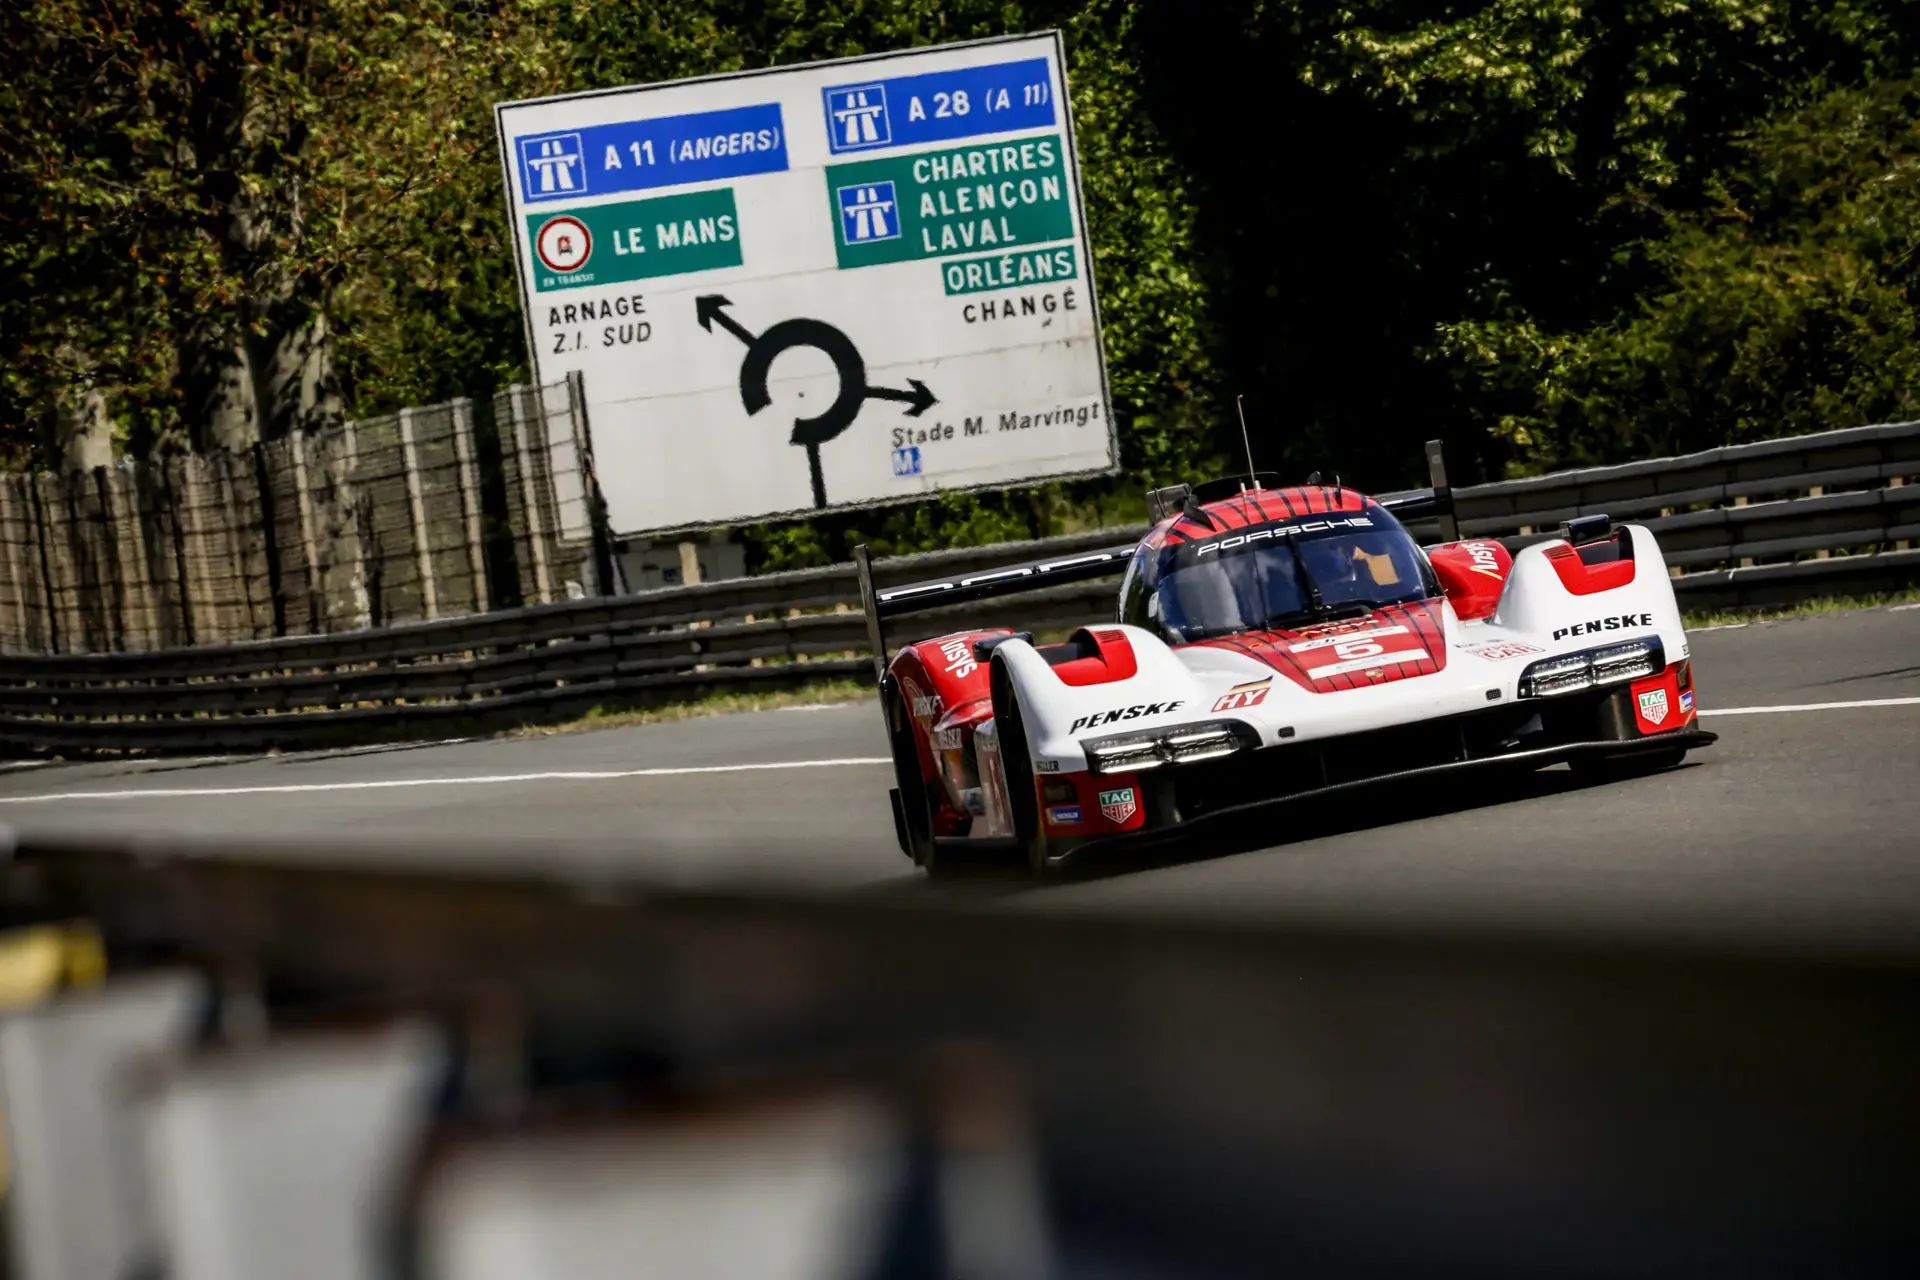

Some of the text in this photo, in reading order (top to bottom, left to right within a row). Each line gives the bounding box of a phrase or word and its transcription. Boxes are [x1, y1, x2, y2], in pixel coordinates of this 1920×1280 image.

[908, 81, 1050, 123] A 28 (A 11)
[604, 126, 781, 171] A 11 (ANGERS)
[912, 141, 1056, 185] CHARTRES
[919, 175, 1061, 218] ALENÇON
[612, 215, 737, 256] LE MANS
[921, 216, 1017, 253] LAVAL
[946, 250, 1074, 292] ORLÉANS
[548, 295, 648, 328] ARNAGE
[962, 287, 1078, 324] CHANGÉ
[552, 321, 653, 355] Z.I. SUD
[891, 401, 1101, 449] Stade M. Marvingt
[1196, 516, 1375, 557] PORSCHE
[1552, 613, 1653, 641] PENSKE
[1334, 638, 1384, 660] 5
[1214, 689, 1267, 712] HY
[1640, 692, 1665, 706] TAG
[1643, 704, 1667, 722] HEUER
[1068, 700, 1186, 735] PENSKE
[1101, 791, 1131, 804] TAG
[1103, 803, 1134, 821] HEUER
